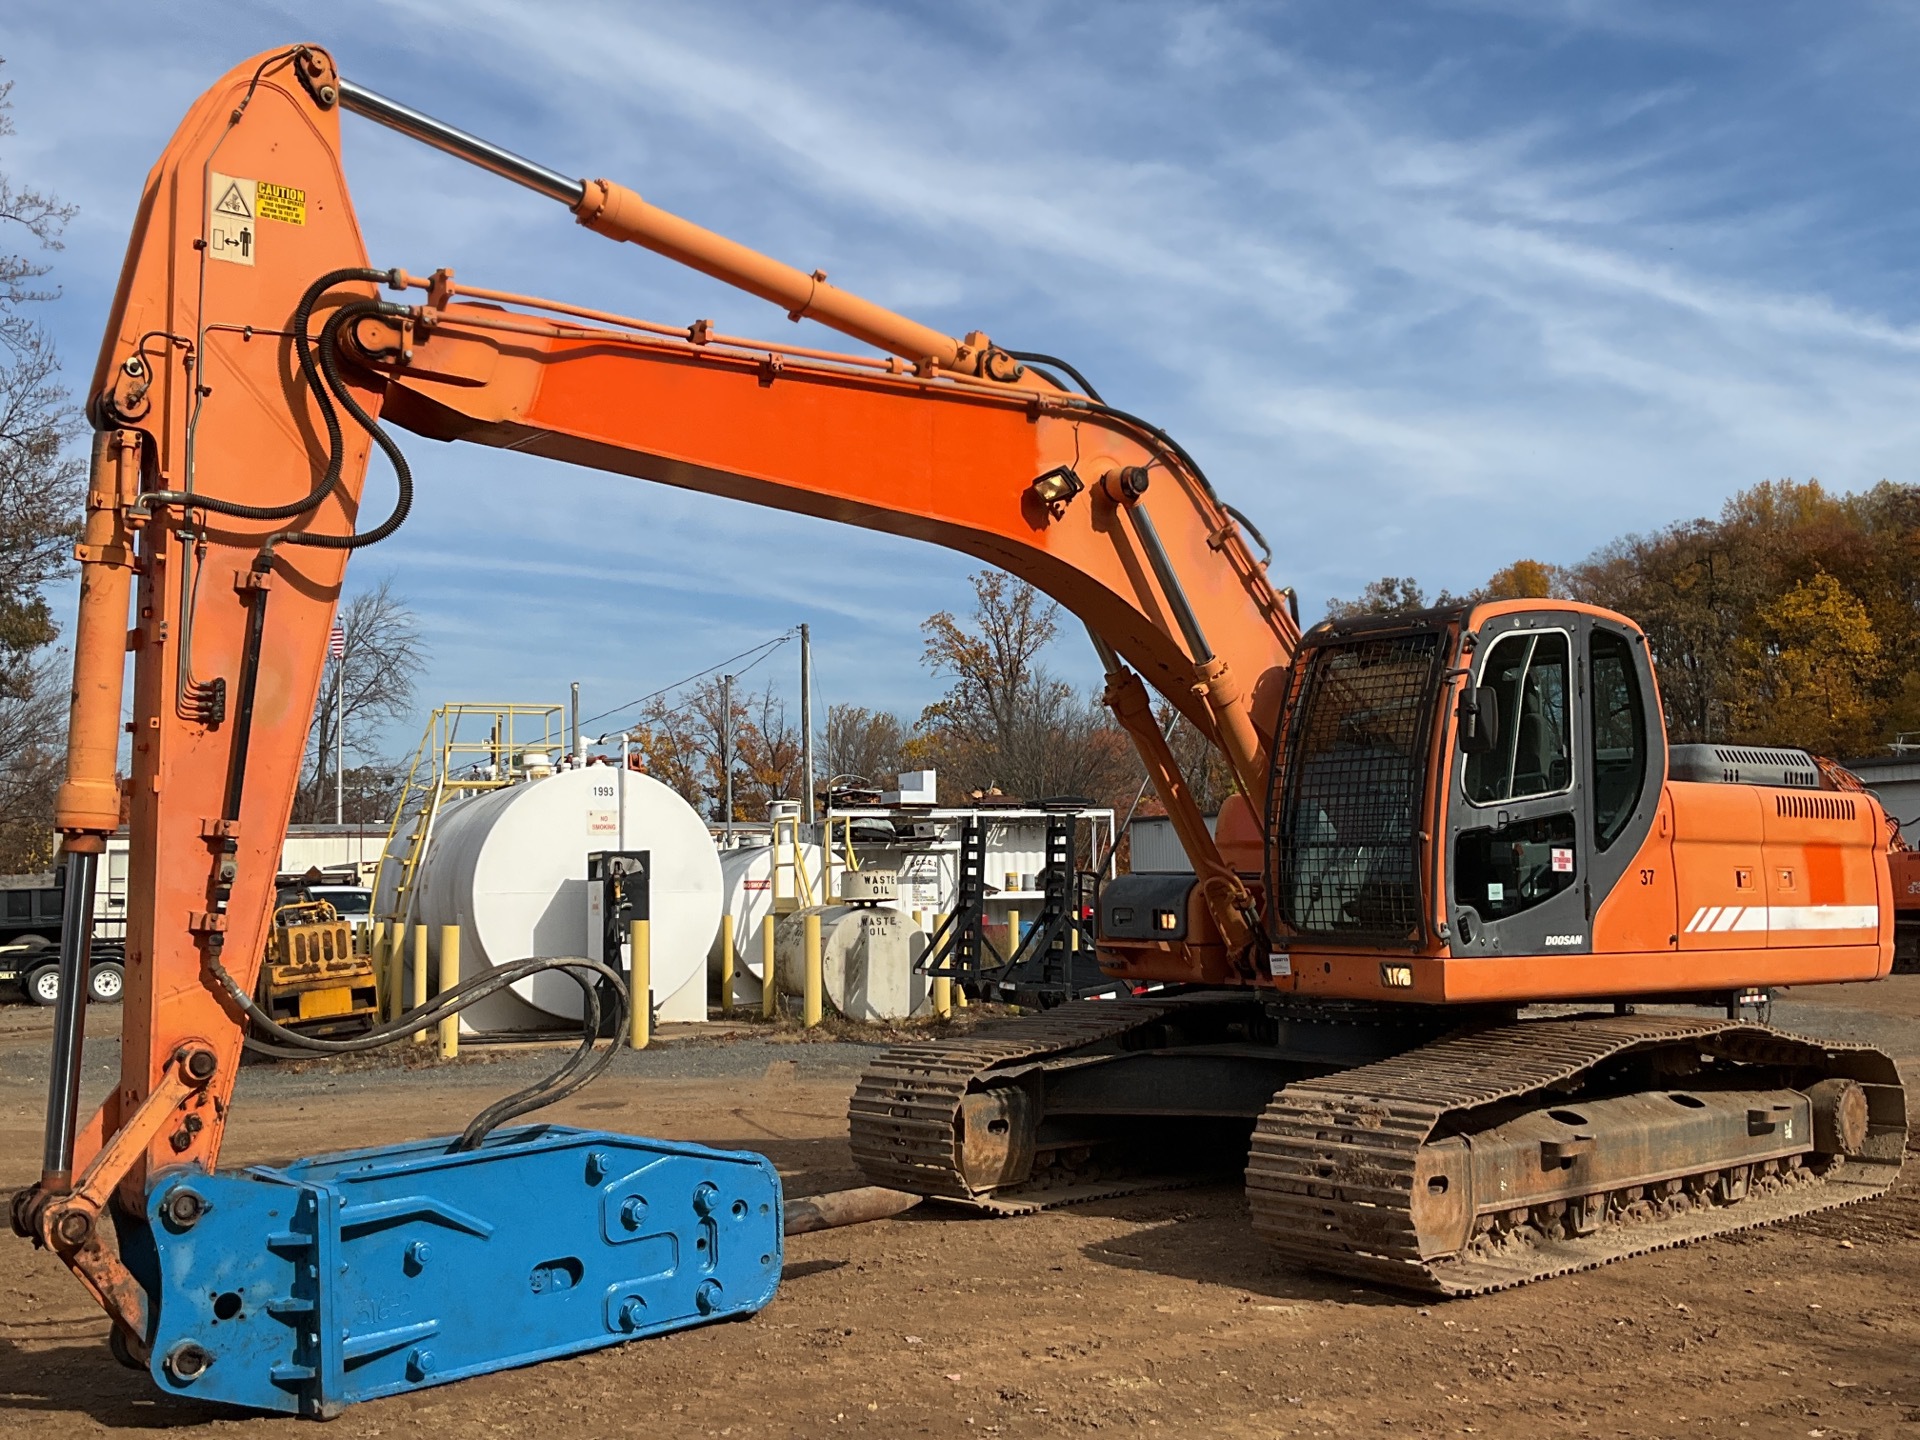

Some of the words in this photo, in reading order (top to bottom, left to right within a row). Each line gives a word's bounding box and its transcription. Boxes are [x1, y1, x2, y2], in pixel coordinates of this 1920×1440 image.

[258, 182, 305, 202] CAUTION
[594, 786, 614, 796] 1993
[864, 875, 895, 885] WASTE
[1640, 869, 1655, 886] 37
[873, 886, 890, 895] OIL
[861, 916, 896, 926] WASTE
[869, 927, 887, 936] OIL
[1545, 935, 1583, 946] DOOSAN
